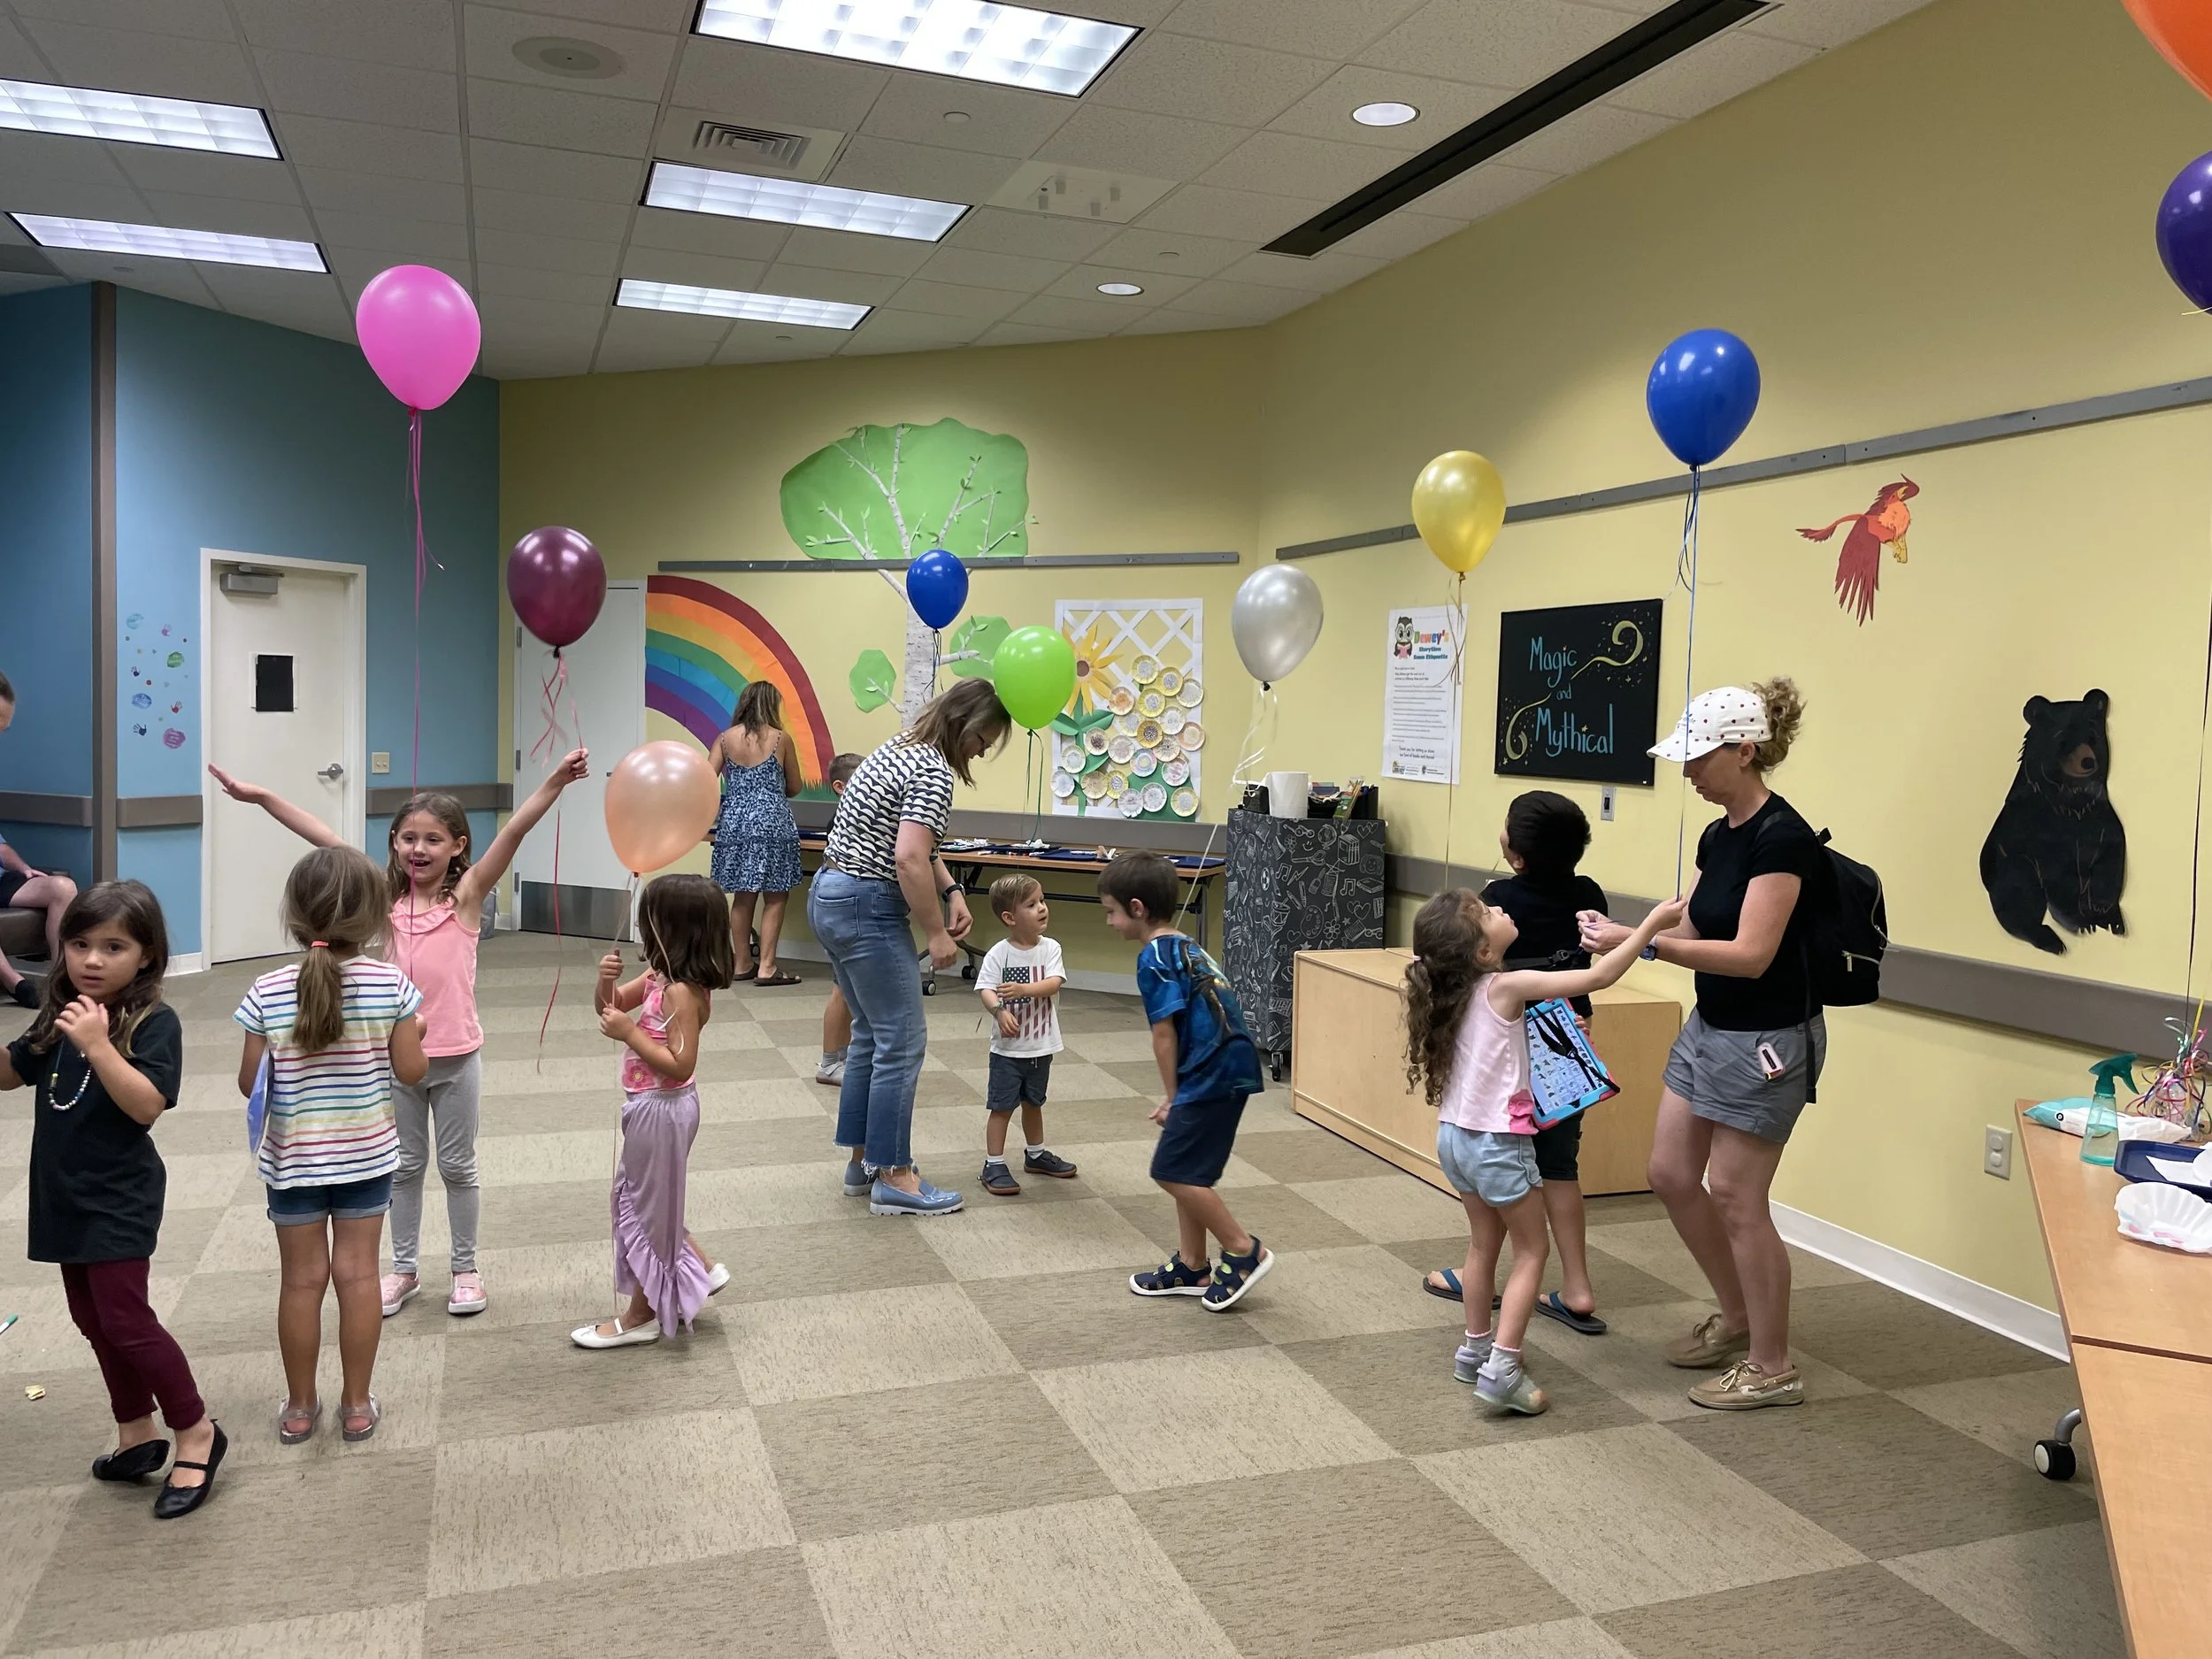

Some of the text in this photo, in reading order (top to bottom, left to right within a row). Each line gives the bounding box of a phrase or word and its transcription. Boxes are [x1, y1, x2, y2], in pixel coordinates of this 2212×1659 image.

[1414, 629, 1449, 645] Dewey's
[1529, 636, 1578, 687] Magic
[1556, 683, 1571, 700] and
[1535, 703, 1614, 757] Mythical
